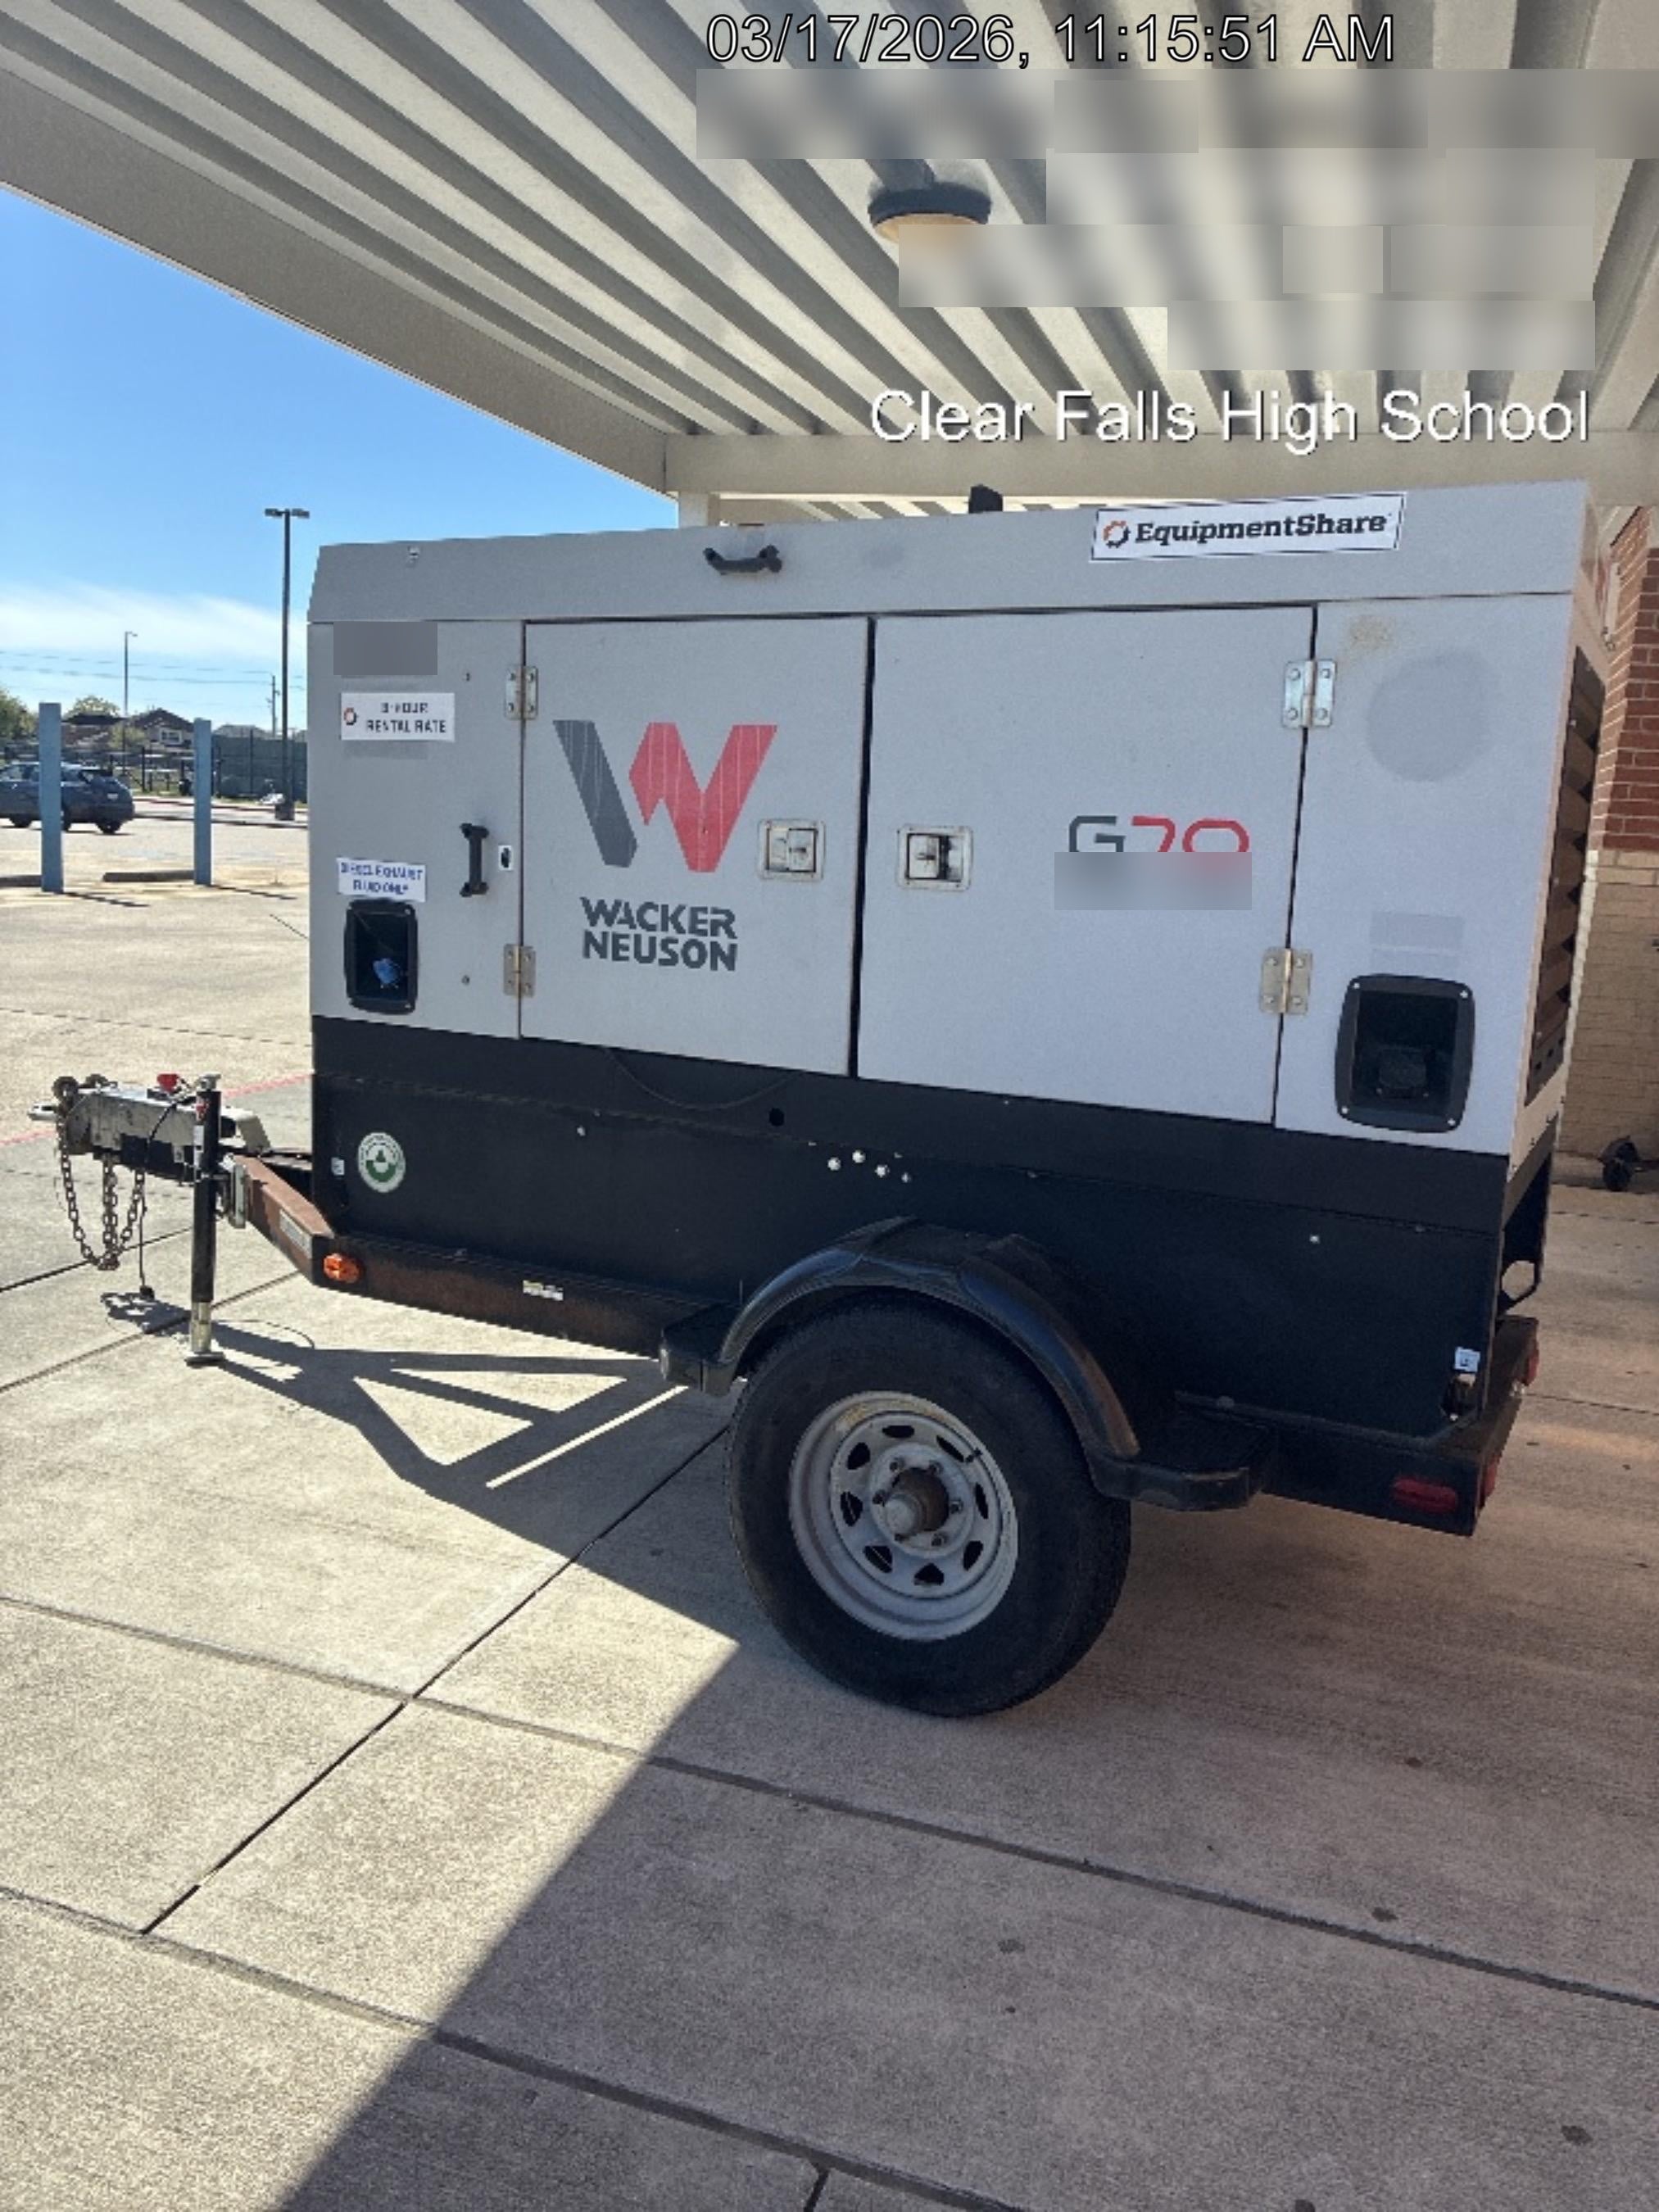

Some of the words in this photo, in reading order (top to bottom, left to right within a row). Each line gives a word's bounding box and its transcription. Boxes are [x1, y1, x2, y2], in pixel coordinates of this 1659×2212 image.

[1135, 513, 1387, 546] EquipmentShare
[414, 719, 446, 733] RATE
[579, 896, 738, 939] WACKER
[582, 930, 738, 971] NEUSON
